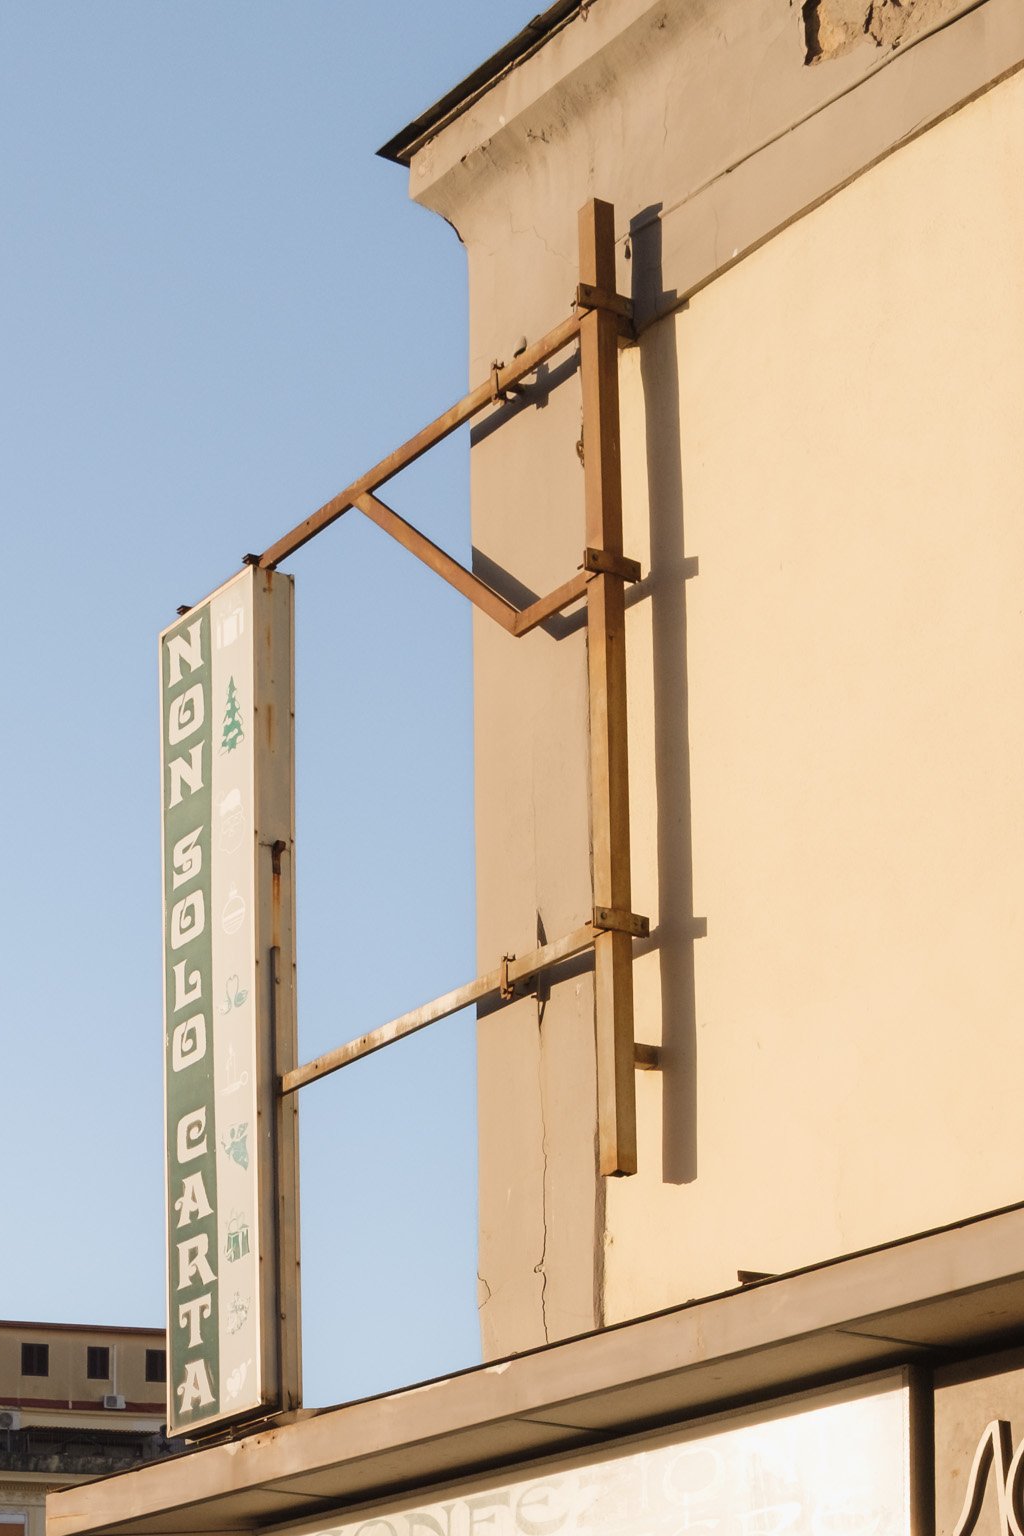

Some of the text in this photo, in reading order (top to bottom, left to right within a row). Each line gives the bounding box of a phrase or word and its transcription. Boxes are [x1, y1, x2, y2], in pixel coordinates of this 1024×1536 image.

[166, 616, 218, 1415] NON SOLO CARTA
